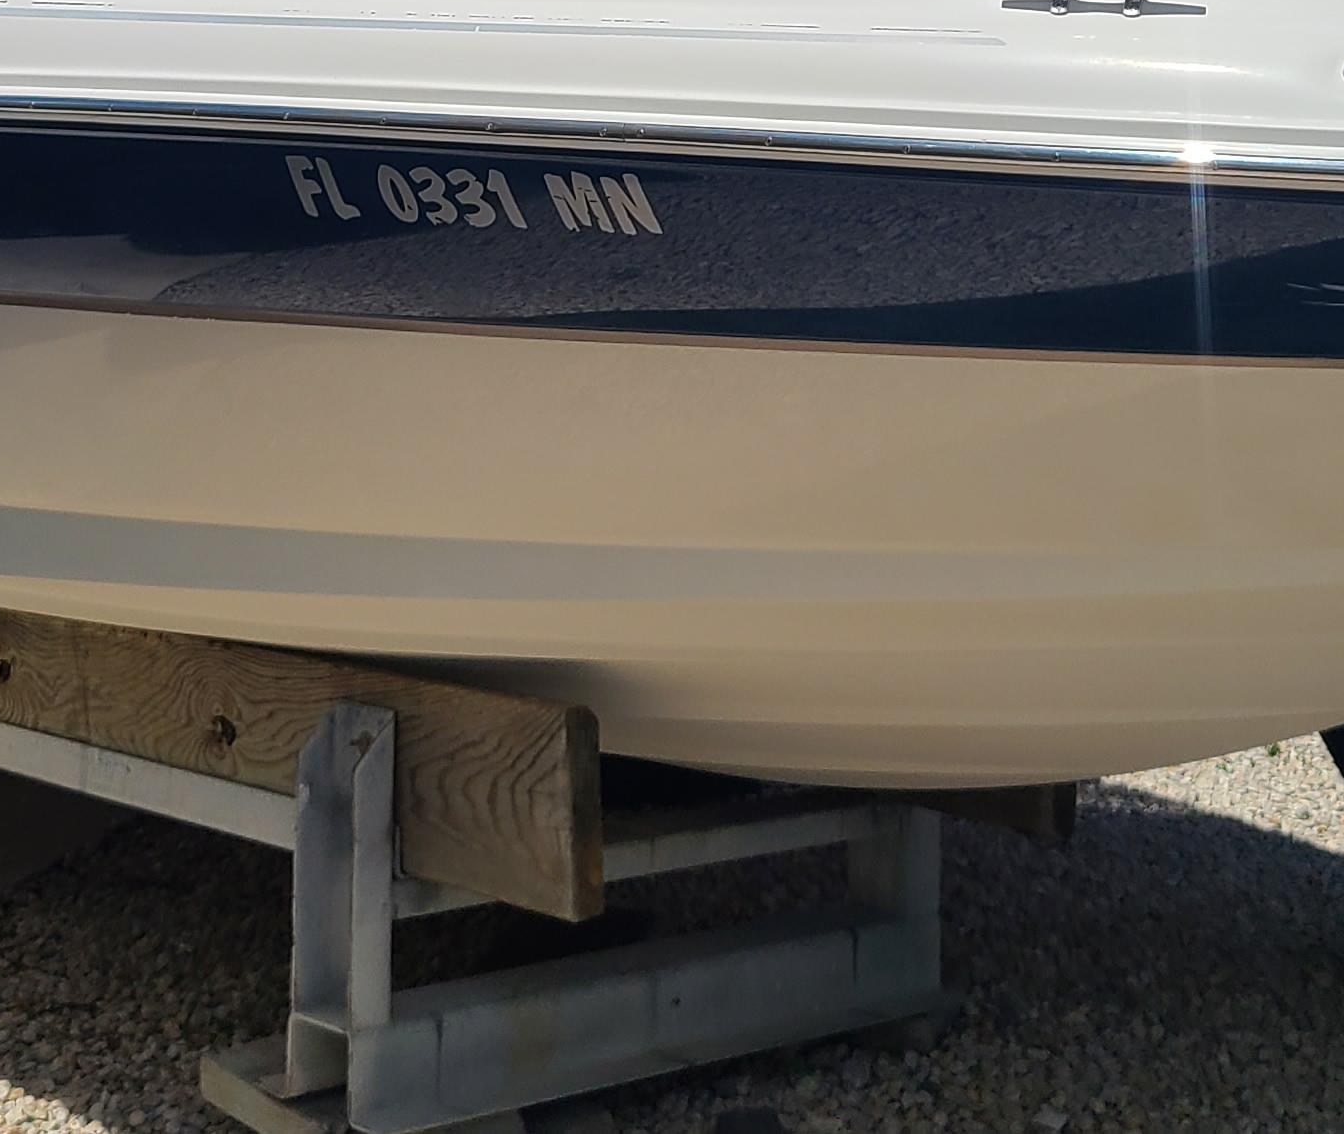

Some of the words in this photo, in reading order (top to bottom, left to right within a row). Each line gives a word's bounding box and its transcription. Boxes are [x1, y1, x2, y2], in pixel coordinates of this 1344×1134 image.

[285, 155, 361, 221] FL
[377, 164, 529, 230] 0331
[543, 170, 664, 236] MN
